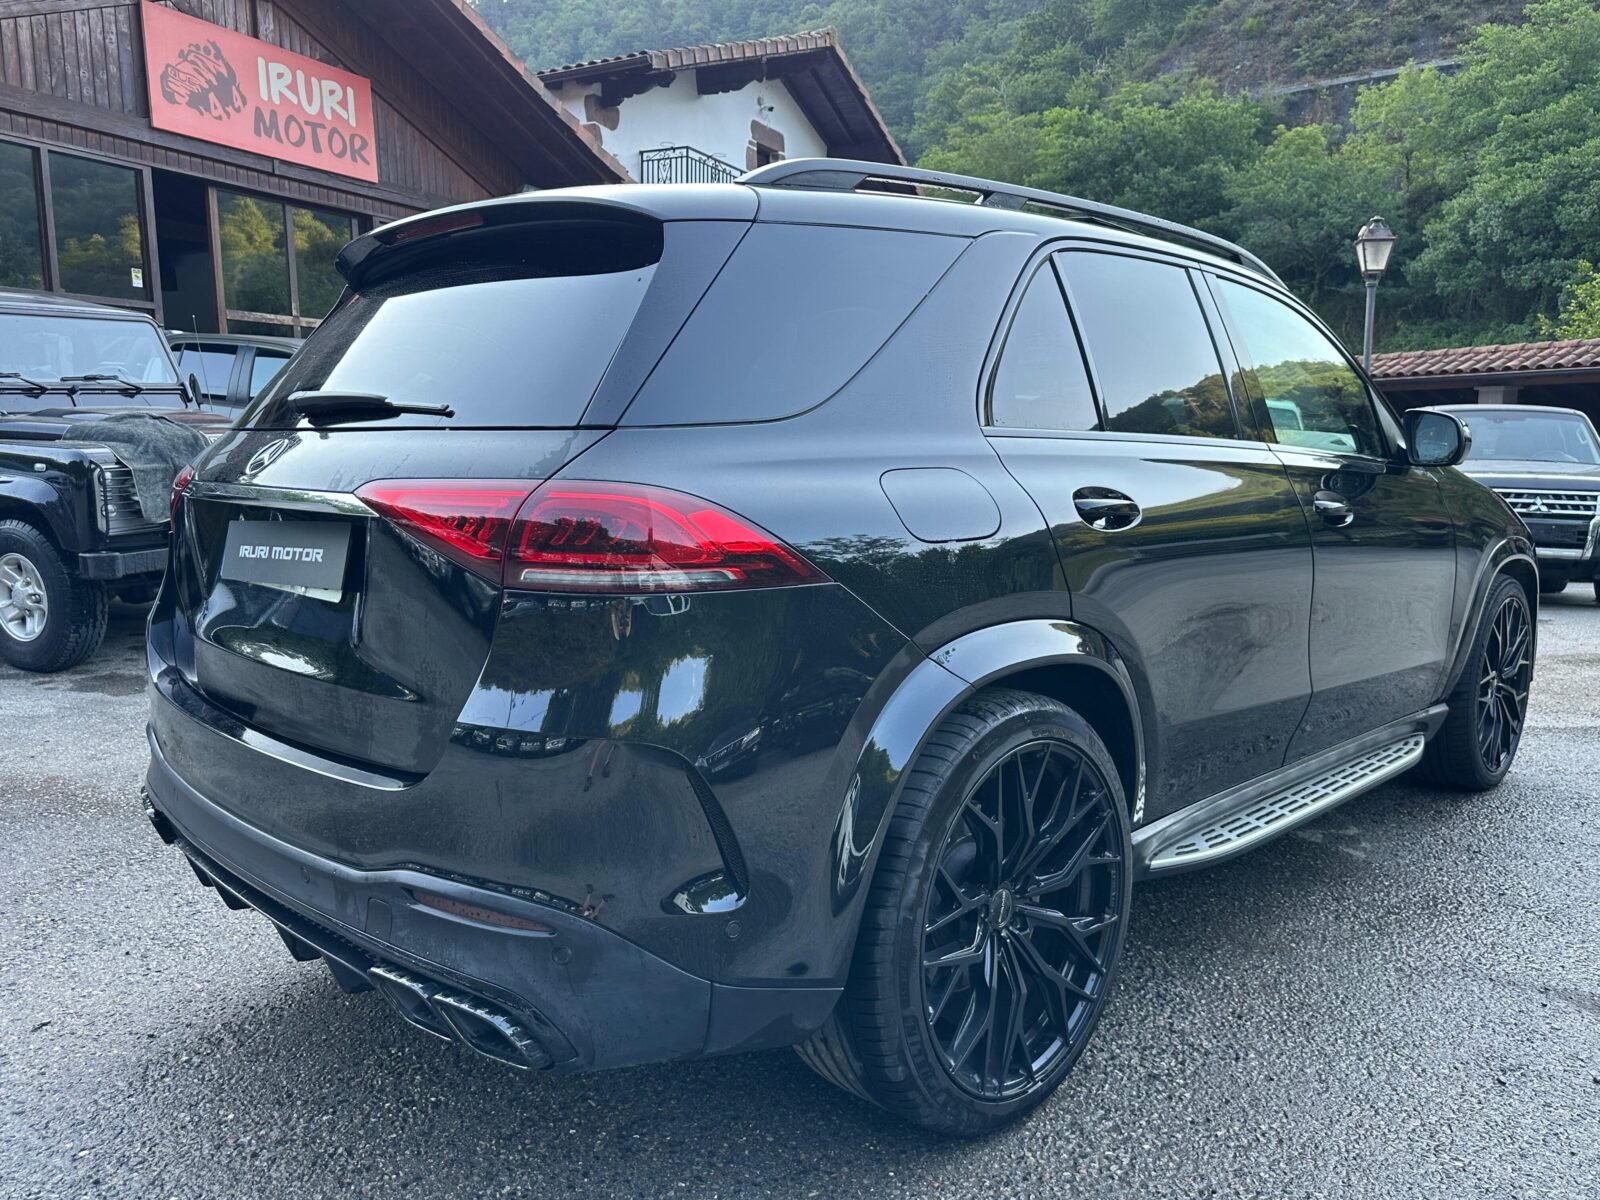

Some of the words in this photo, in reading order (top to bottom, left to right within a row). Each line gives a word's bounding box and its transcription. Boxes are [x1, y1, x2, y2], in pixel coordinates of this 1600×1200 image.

[257, 56, 357, 127] IRURI
[253, 106, 371, 165] MOTOR
[239, 545, 269, 559] IRURI
[271, 546, 324, 562] MOTOR
